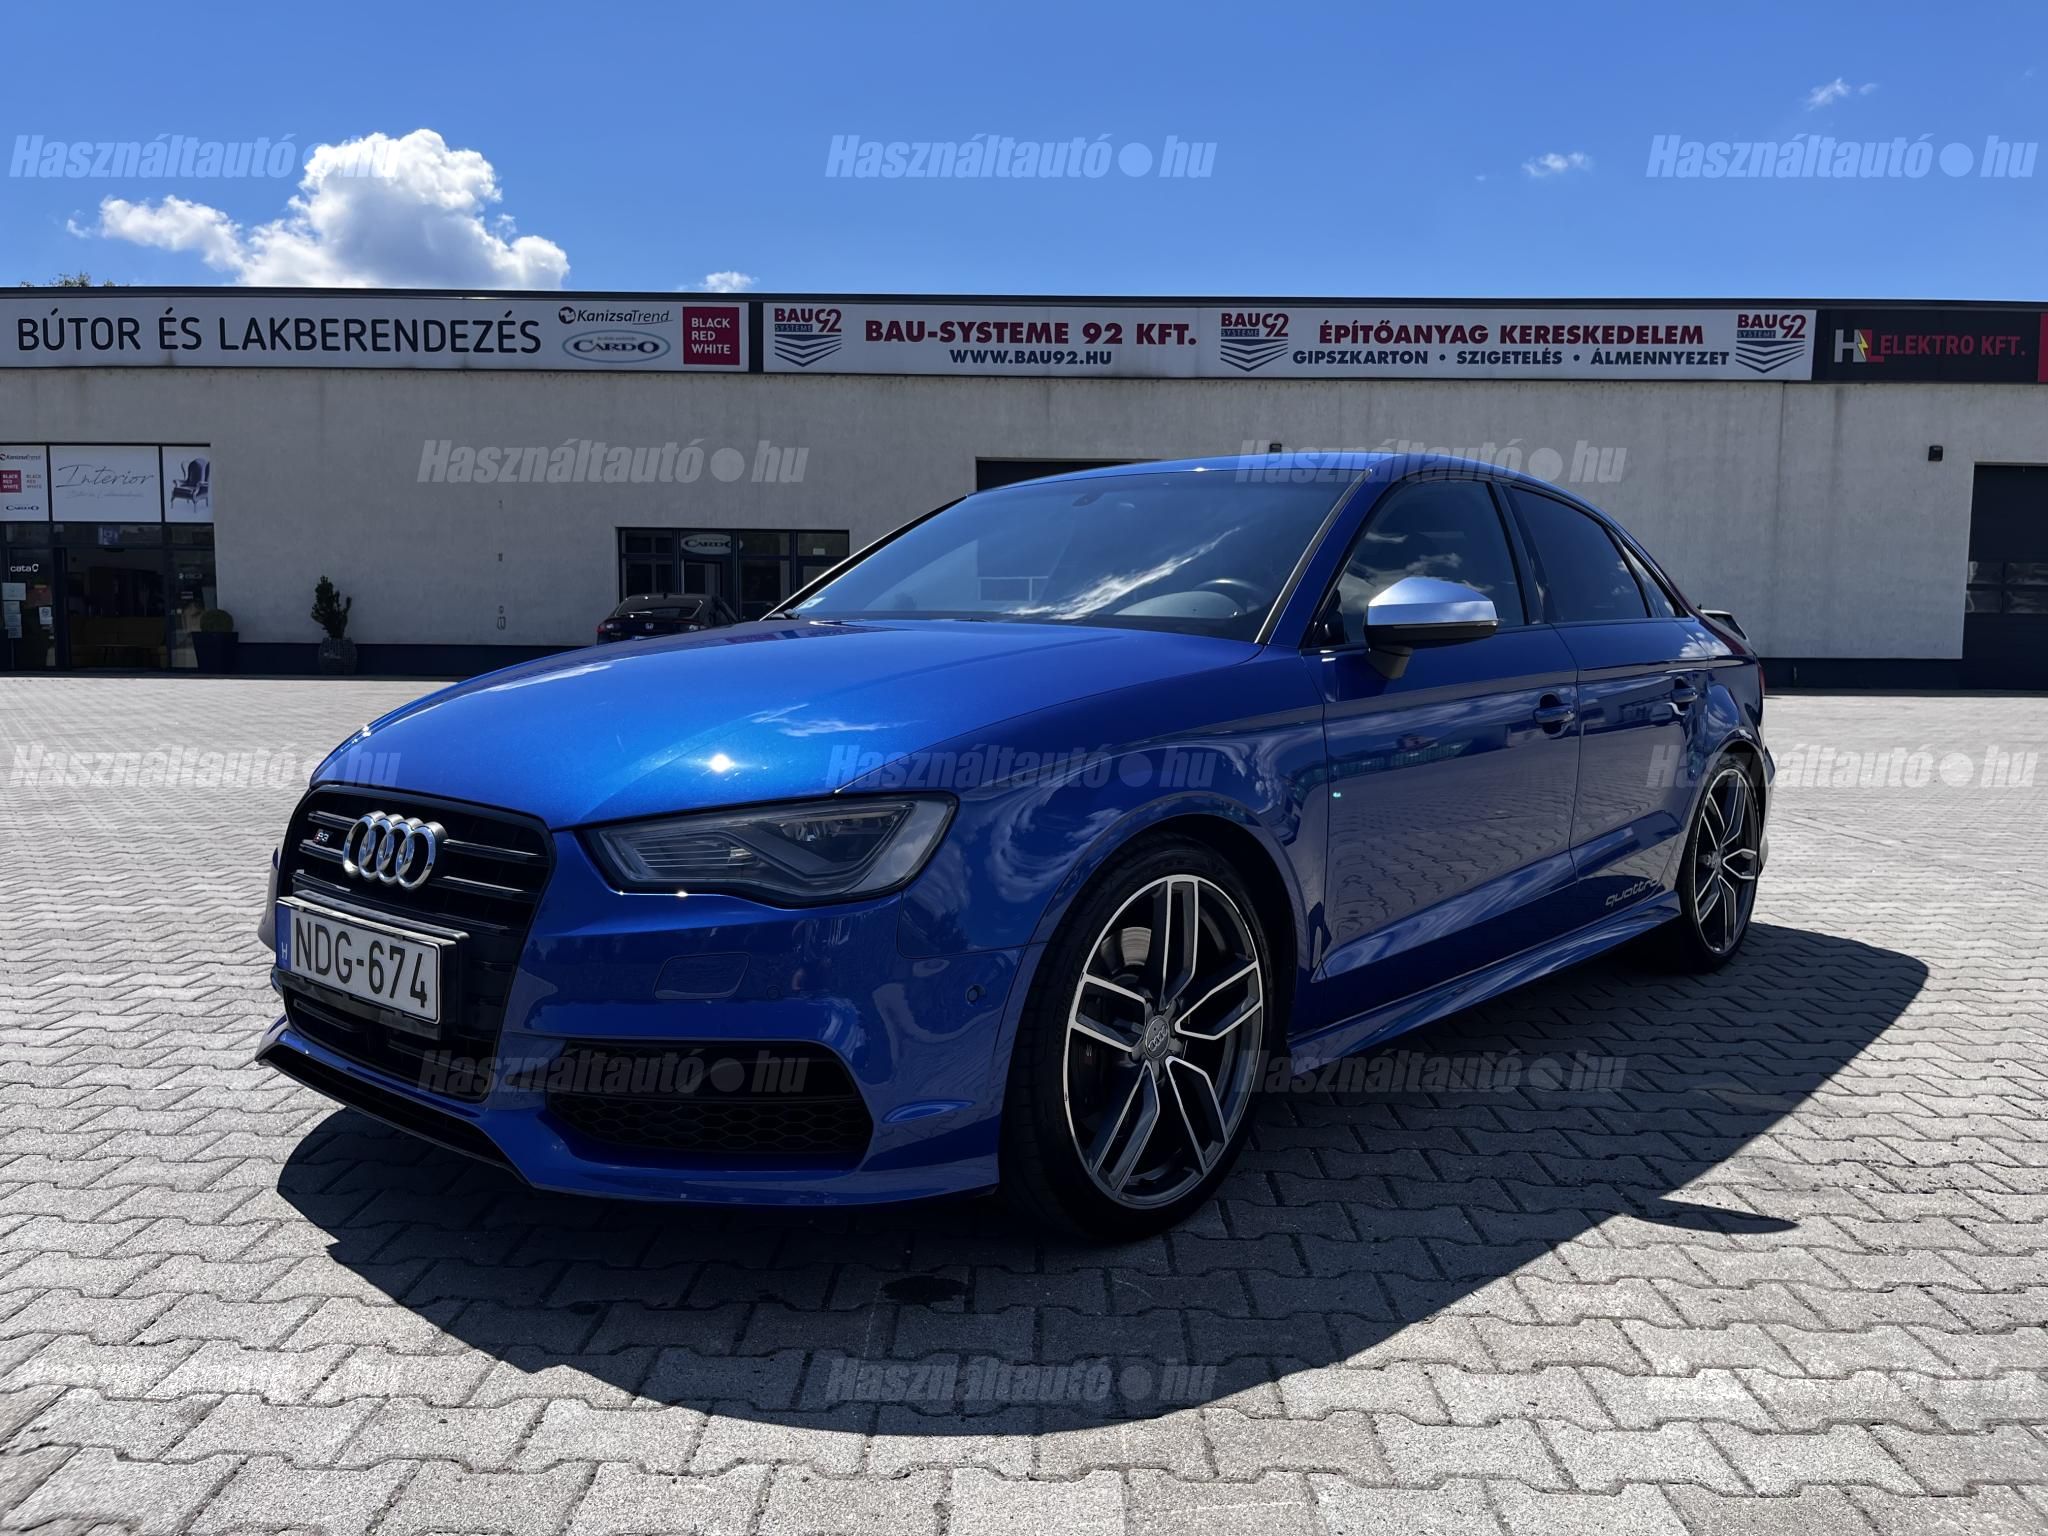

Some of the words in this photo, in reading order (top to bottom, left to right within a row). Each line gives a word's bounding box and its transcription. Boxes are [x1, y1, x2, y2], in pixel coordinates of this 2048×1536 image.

[577, 309, 671, 323] KanizsaTrend
[691, 317, 731, 329] BLACK
[17, 308, 142, 351] BÚTOR
[158, 307, 203, 351] ÉS
[218, 310, 542, 354] LAKBERENDEZÉS
[691, 331, 716, 342] RED
[865, 320, 1069, 345] BAU-SYSTEME
[1082, 322, 1123, 345] 92
[1136, 323, 1197, 346] KFT.
[1319, 319, 1489, 345] ÉPÍTŐANYAG
[1500, 323, 1704, 345] KERESKEDELEM
[691, 344, 731, 355] WHITE
[1880, 335, 1975, 355] ELEKTRO
[1981, 335, 2027, 356] KFT.
[949, 349, 1112, 365] WWW.BAU92.HU
[1292, 349, 1429, 365] GIPSZKARTON
[1456, 347, 1563, 366] SZIGETELÉS
[1590, 347, 1730, 366] ÁLMENNYEZET
[56, 463, 155, 488] Interior
[1605, 879, 1661, 908] quattro
[281, 941, 288, 961] H
[294, 917, 428, 1010] NDG-674
